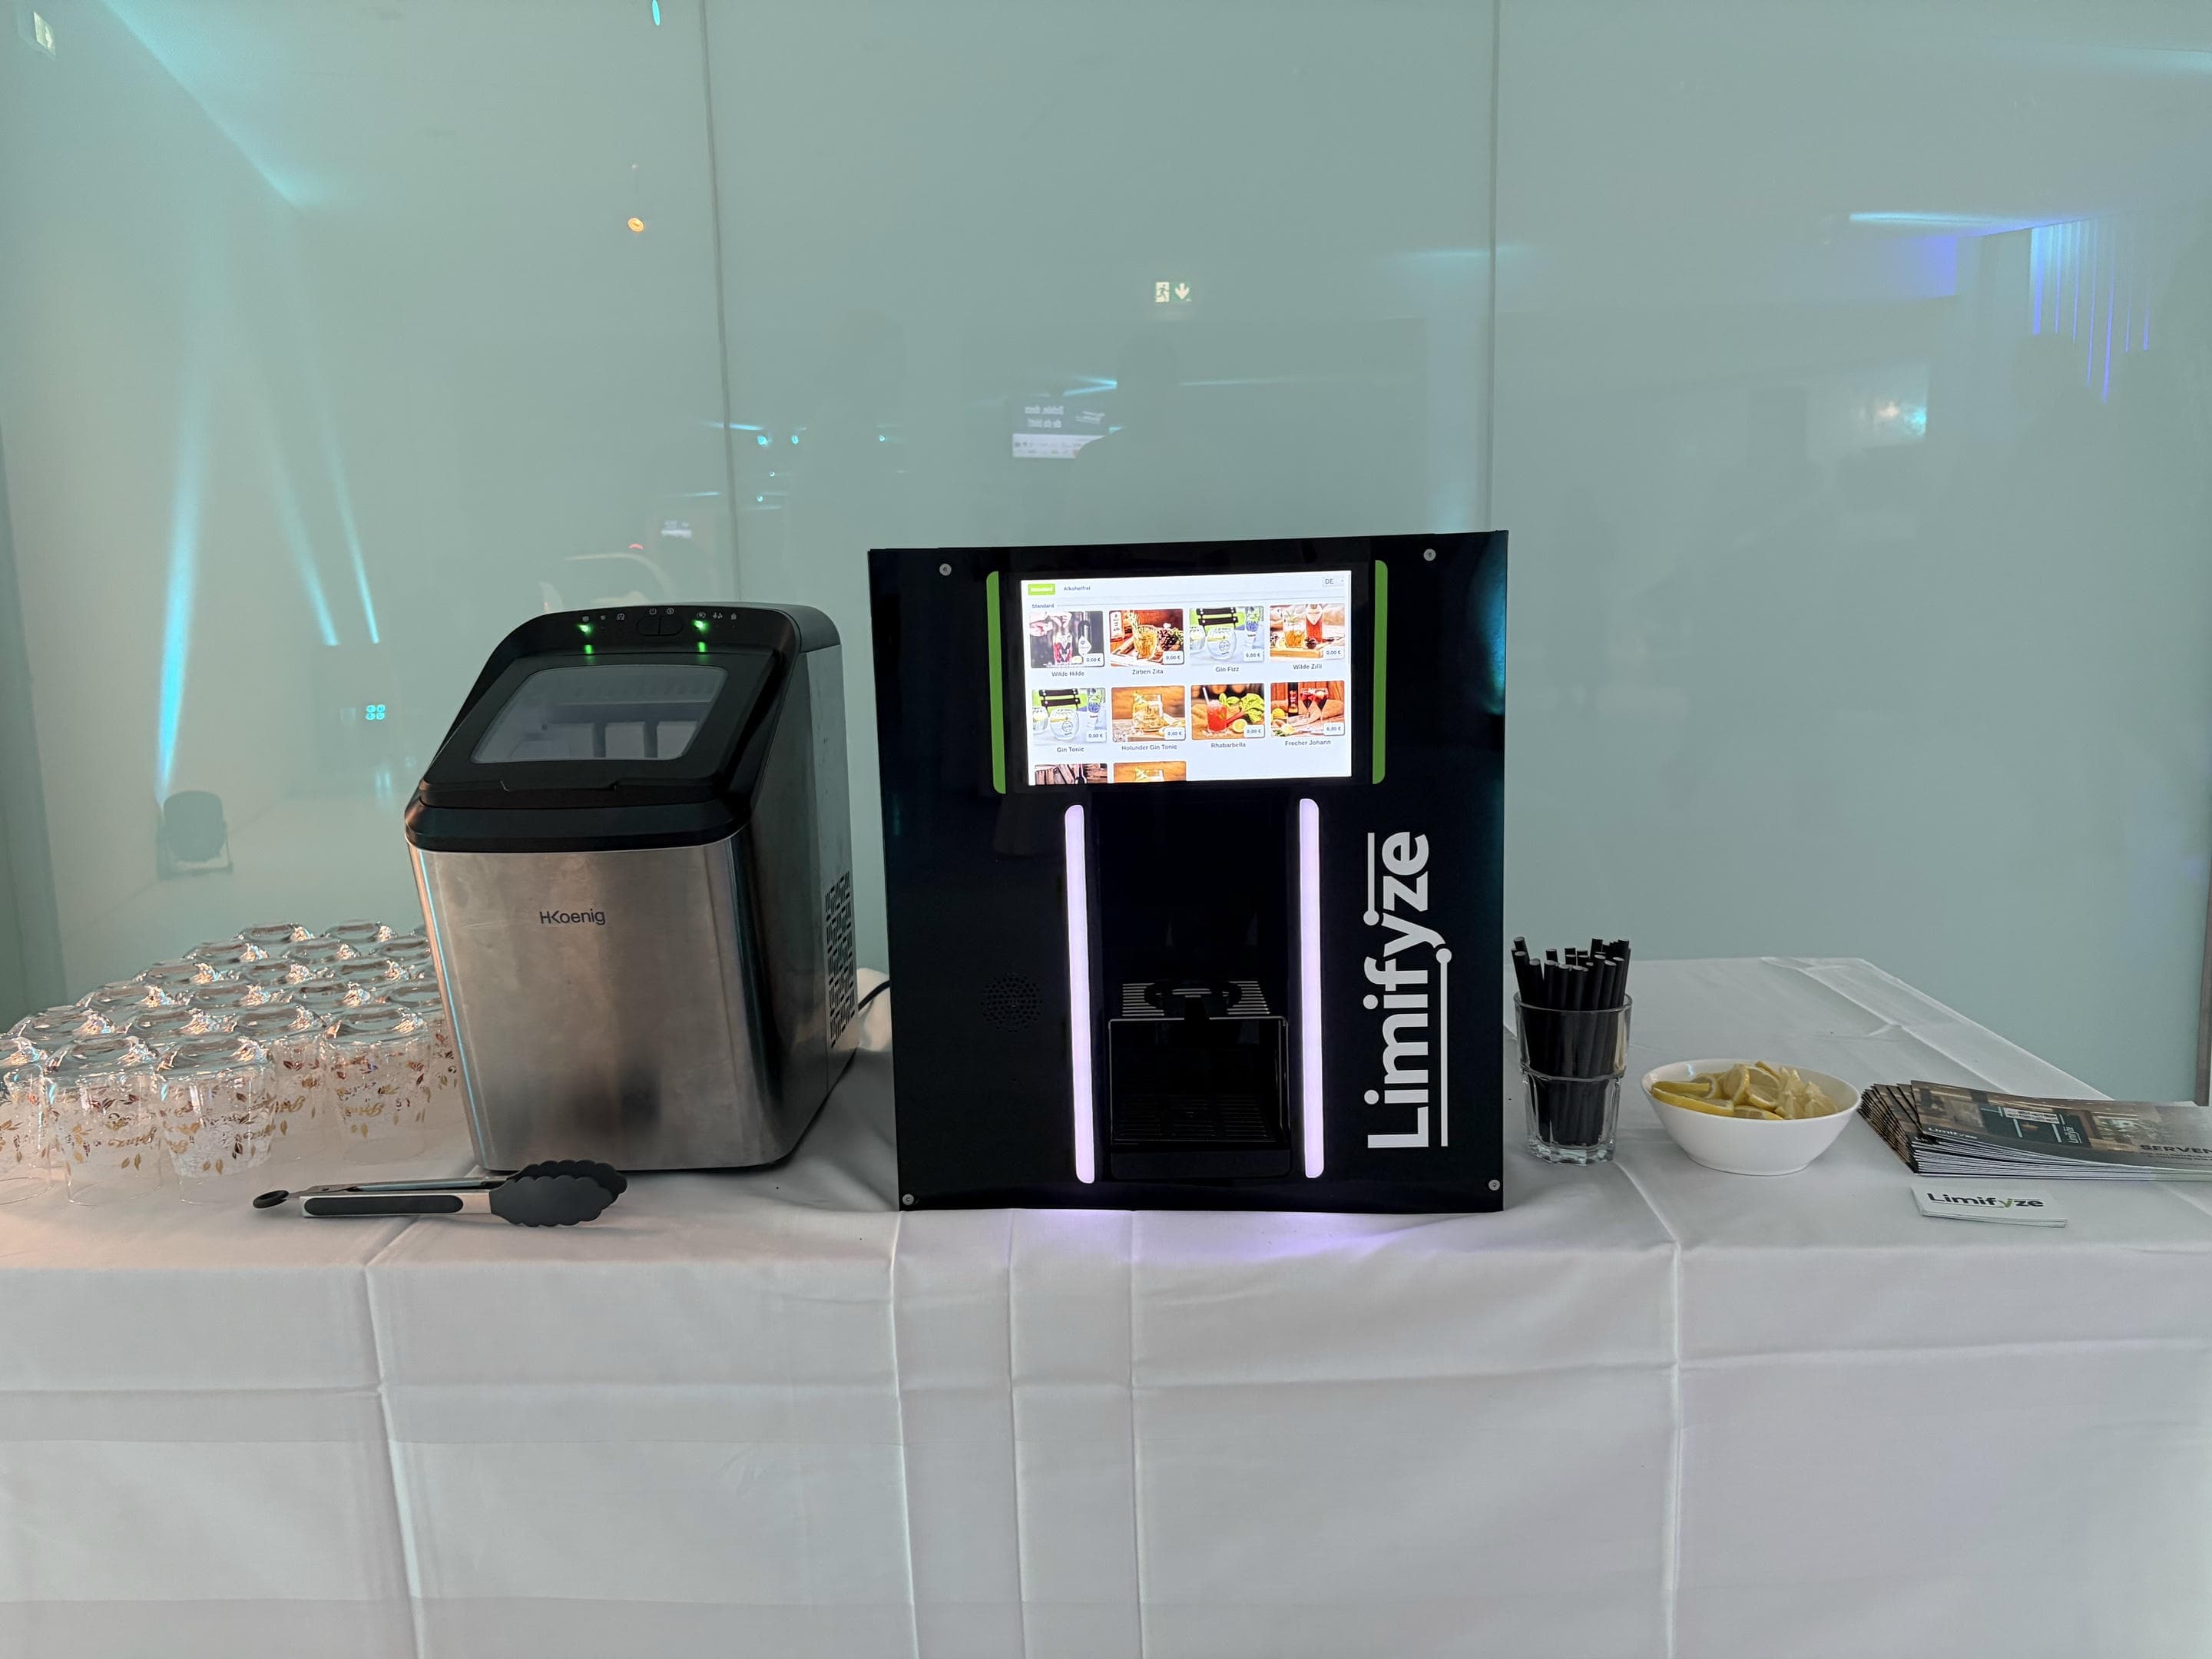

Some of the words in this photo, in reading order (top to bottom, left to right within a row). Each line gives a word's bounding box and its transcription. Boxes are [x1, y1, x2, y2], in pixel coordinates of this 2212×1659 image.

[539, 908, 606, 926] HKoenig
[1363, 831, 1447, 1149] Limifyze
[1926, 1193, 2045, 1208] Limifyze
